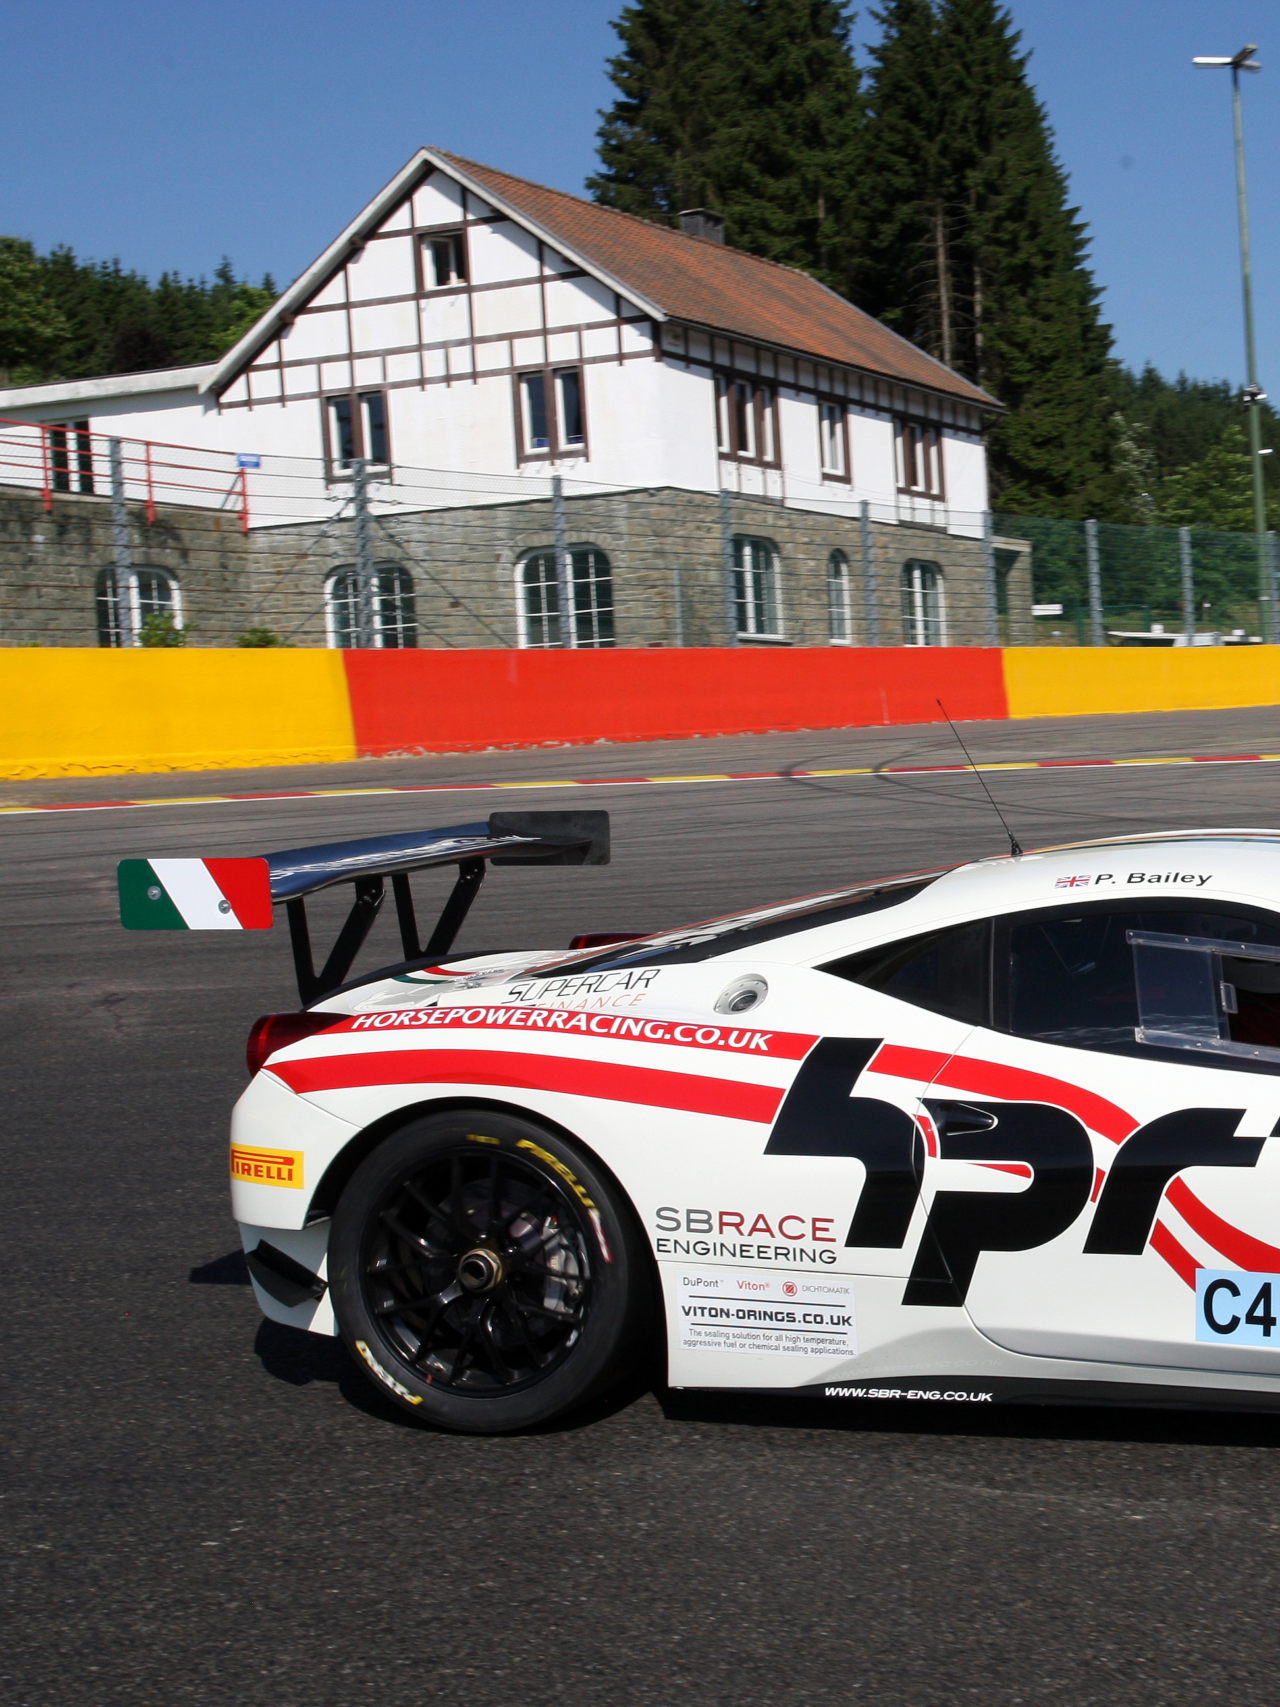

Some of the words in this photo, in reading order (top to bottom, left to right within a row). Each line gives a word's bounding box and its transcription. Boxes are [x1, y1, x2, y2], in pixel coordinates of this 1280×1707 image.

[1094, 873, 1117, 885] P.
[1126, 872, 1214, 887] Bailey
[500, 968, 661, 1005] SUPERCAR
[350, 1007, 774, 1051] HORSEPOWERRACING.CO.UK
[231, 1148, 295, 1182] PIRELLI
[655, 1238, 838, 1265] ENGINEERING
[801, 1284, 851, 1295] DICHTOMATIK
[681, 1305, 853, 1327] VITON-ORINGS.CO.UK
[1203, 1278, 1277, 1338] C4
[682, 1339, 722, 1348] aggressive
[723, 1340, 738, 1349] fuel
[748, 1342, 781, 1352] chemical
[782, 1344, 809, 1355] sealing
[809, 1346, 857, 1357] applications.
[688, 1328, 703, 1337] The
[704, 1330, 731, 1340] sealing
[731, 1331, 761, 1341] solution
[762, 1333, 773, 1341] for
[774, 1334, 784, 1342] all
[784, 1334, 802, 1344] high
[802, 1336, 849, 1347] temperature,
[824, 1387, 994, 1402] WWW.SBR-ENG.CO.UK
